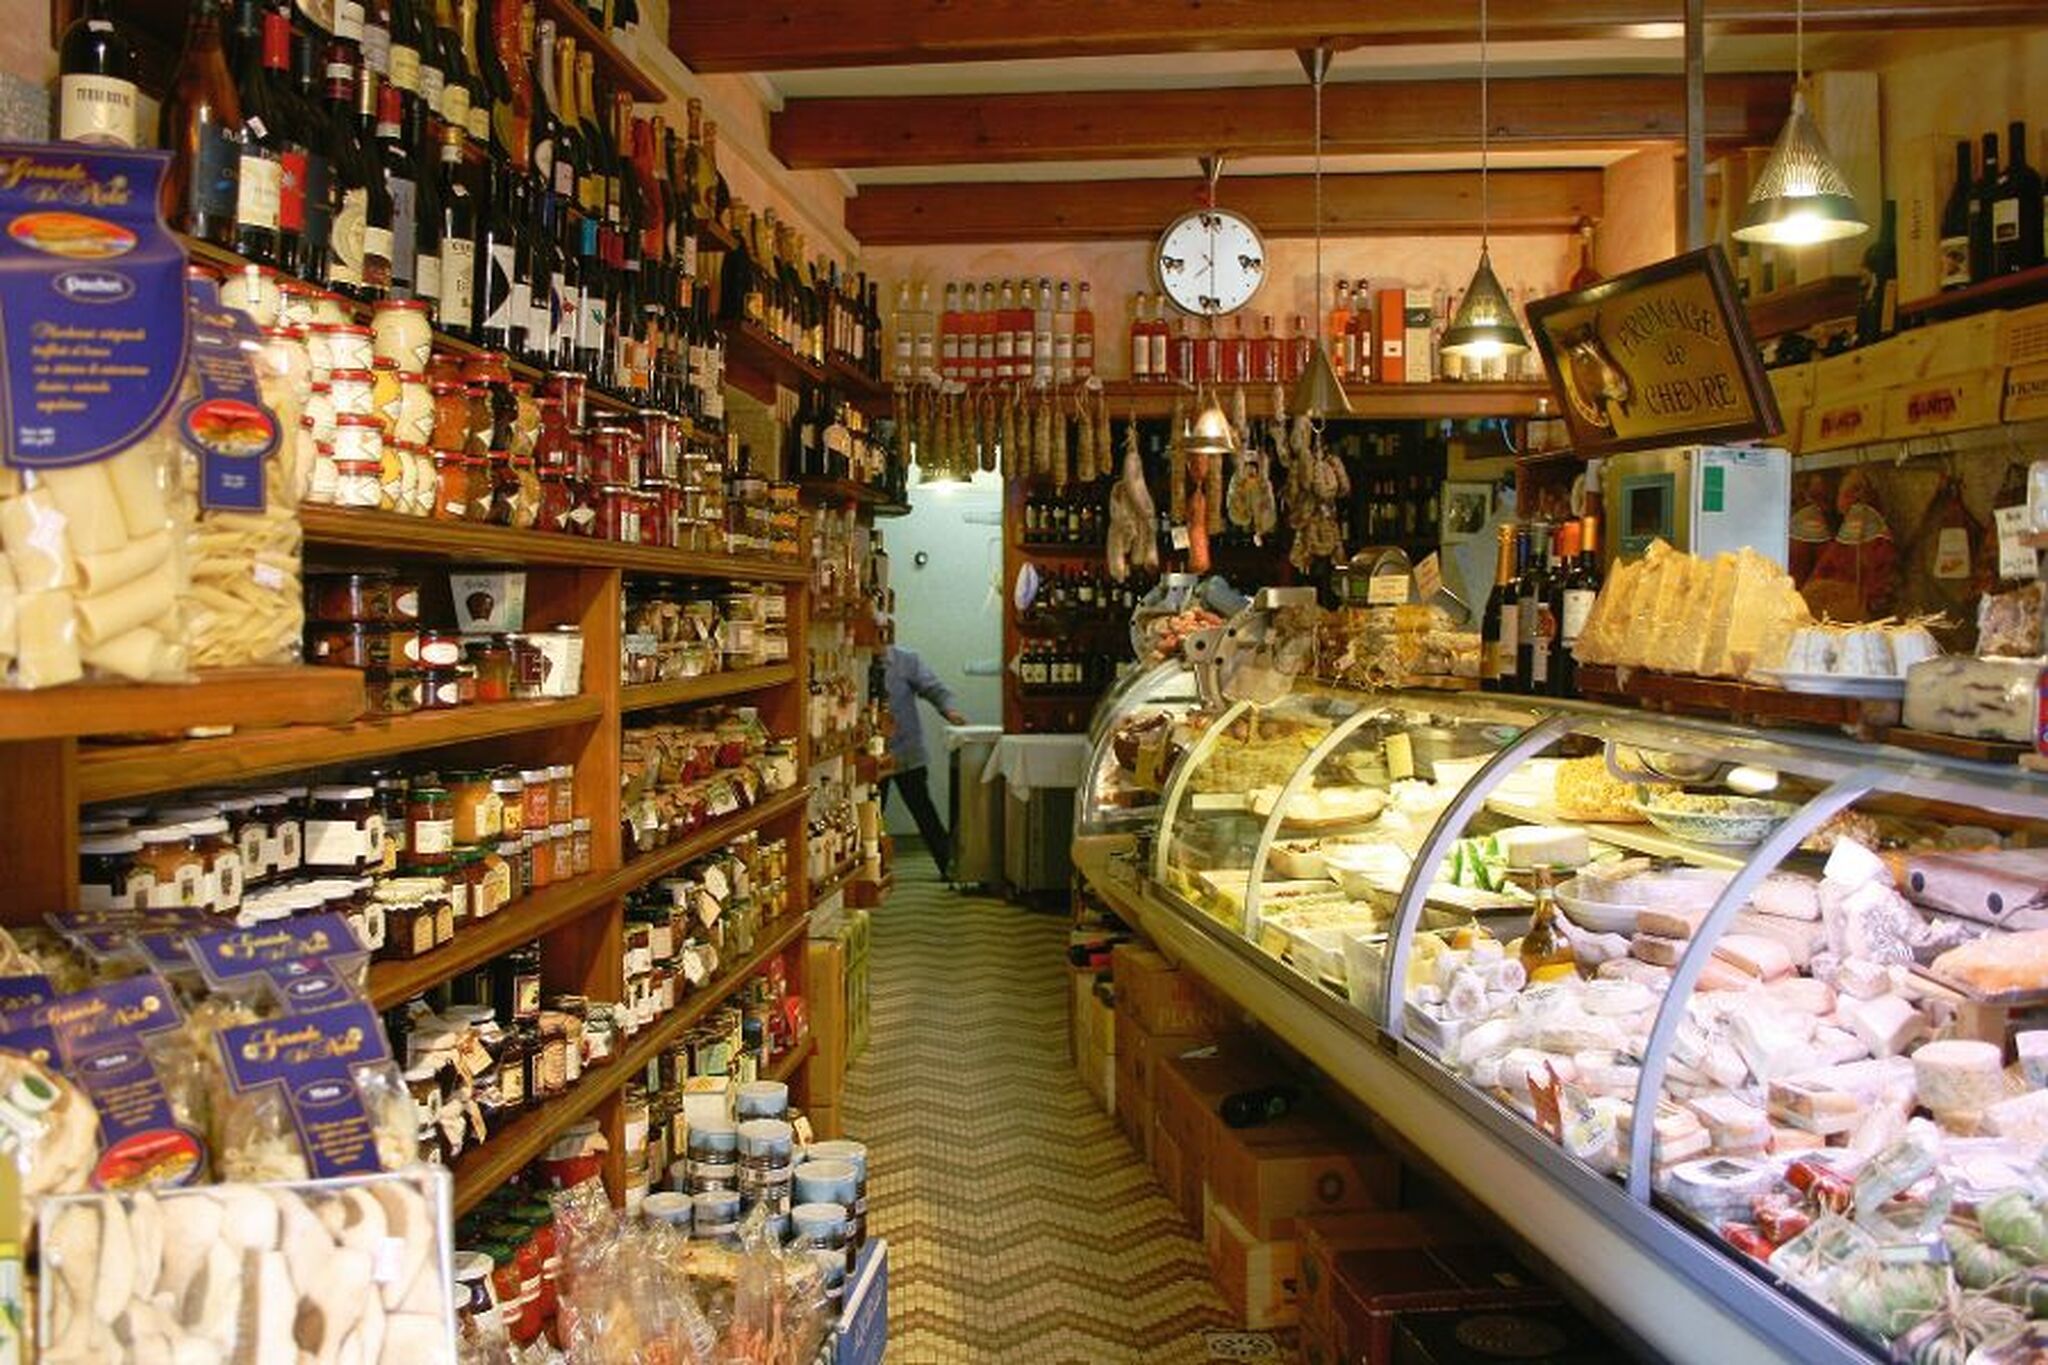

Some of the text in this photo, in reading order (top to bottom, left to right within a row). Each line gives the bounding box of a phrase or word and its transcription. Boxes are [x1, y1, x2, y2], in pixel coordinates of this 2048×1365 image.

[1619, 298, 1720, 358] FROMAGE
[1663, 342, 1688, 366] de
[1642, 372, 1738, 416] CHEVRE
